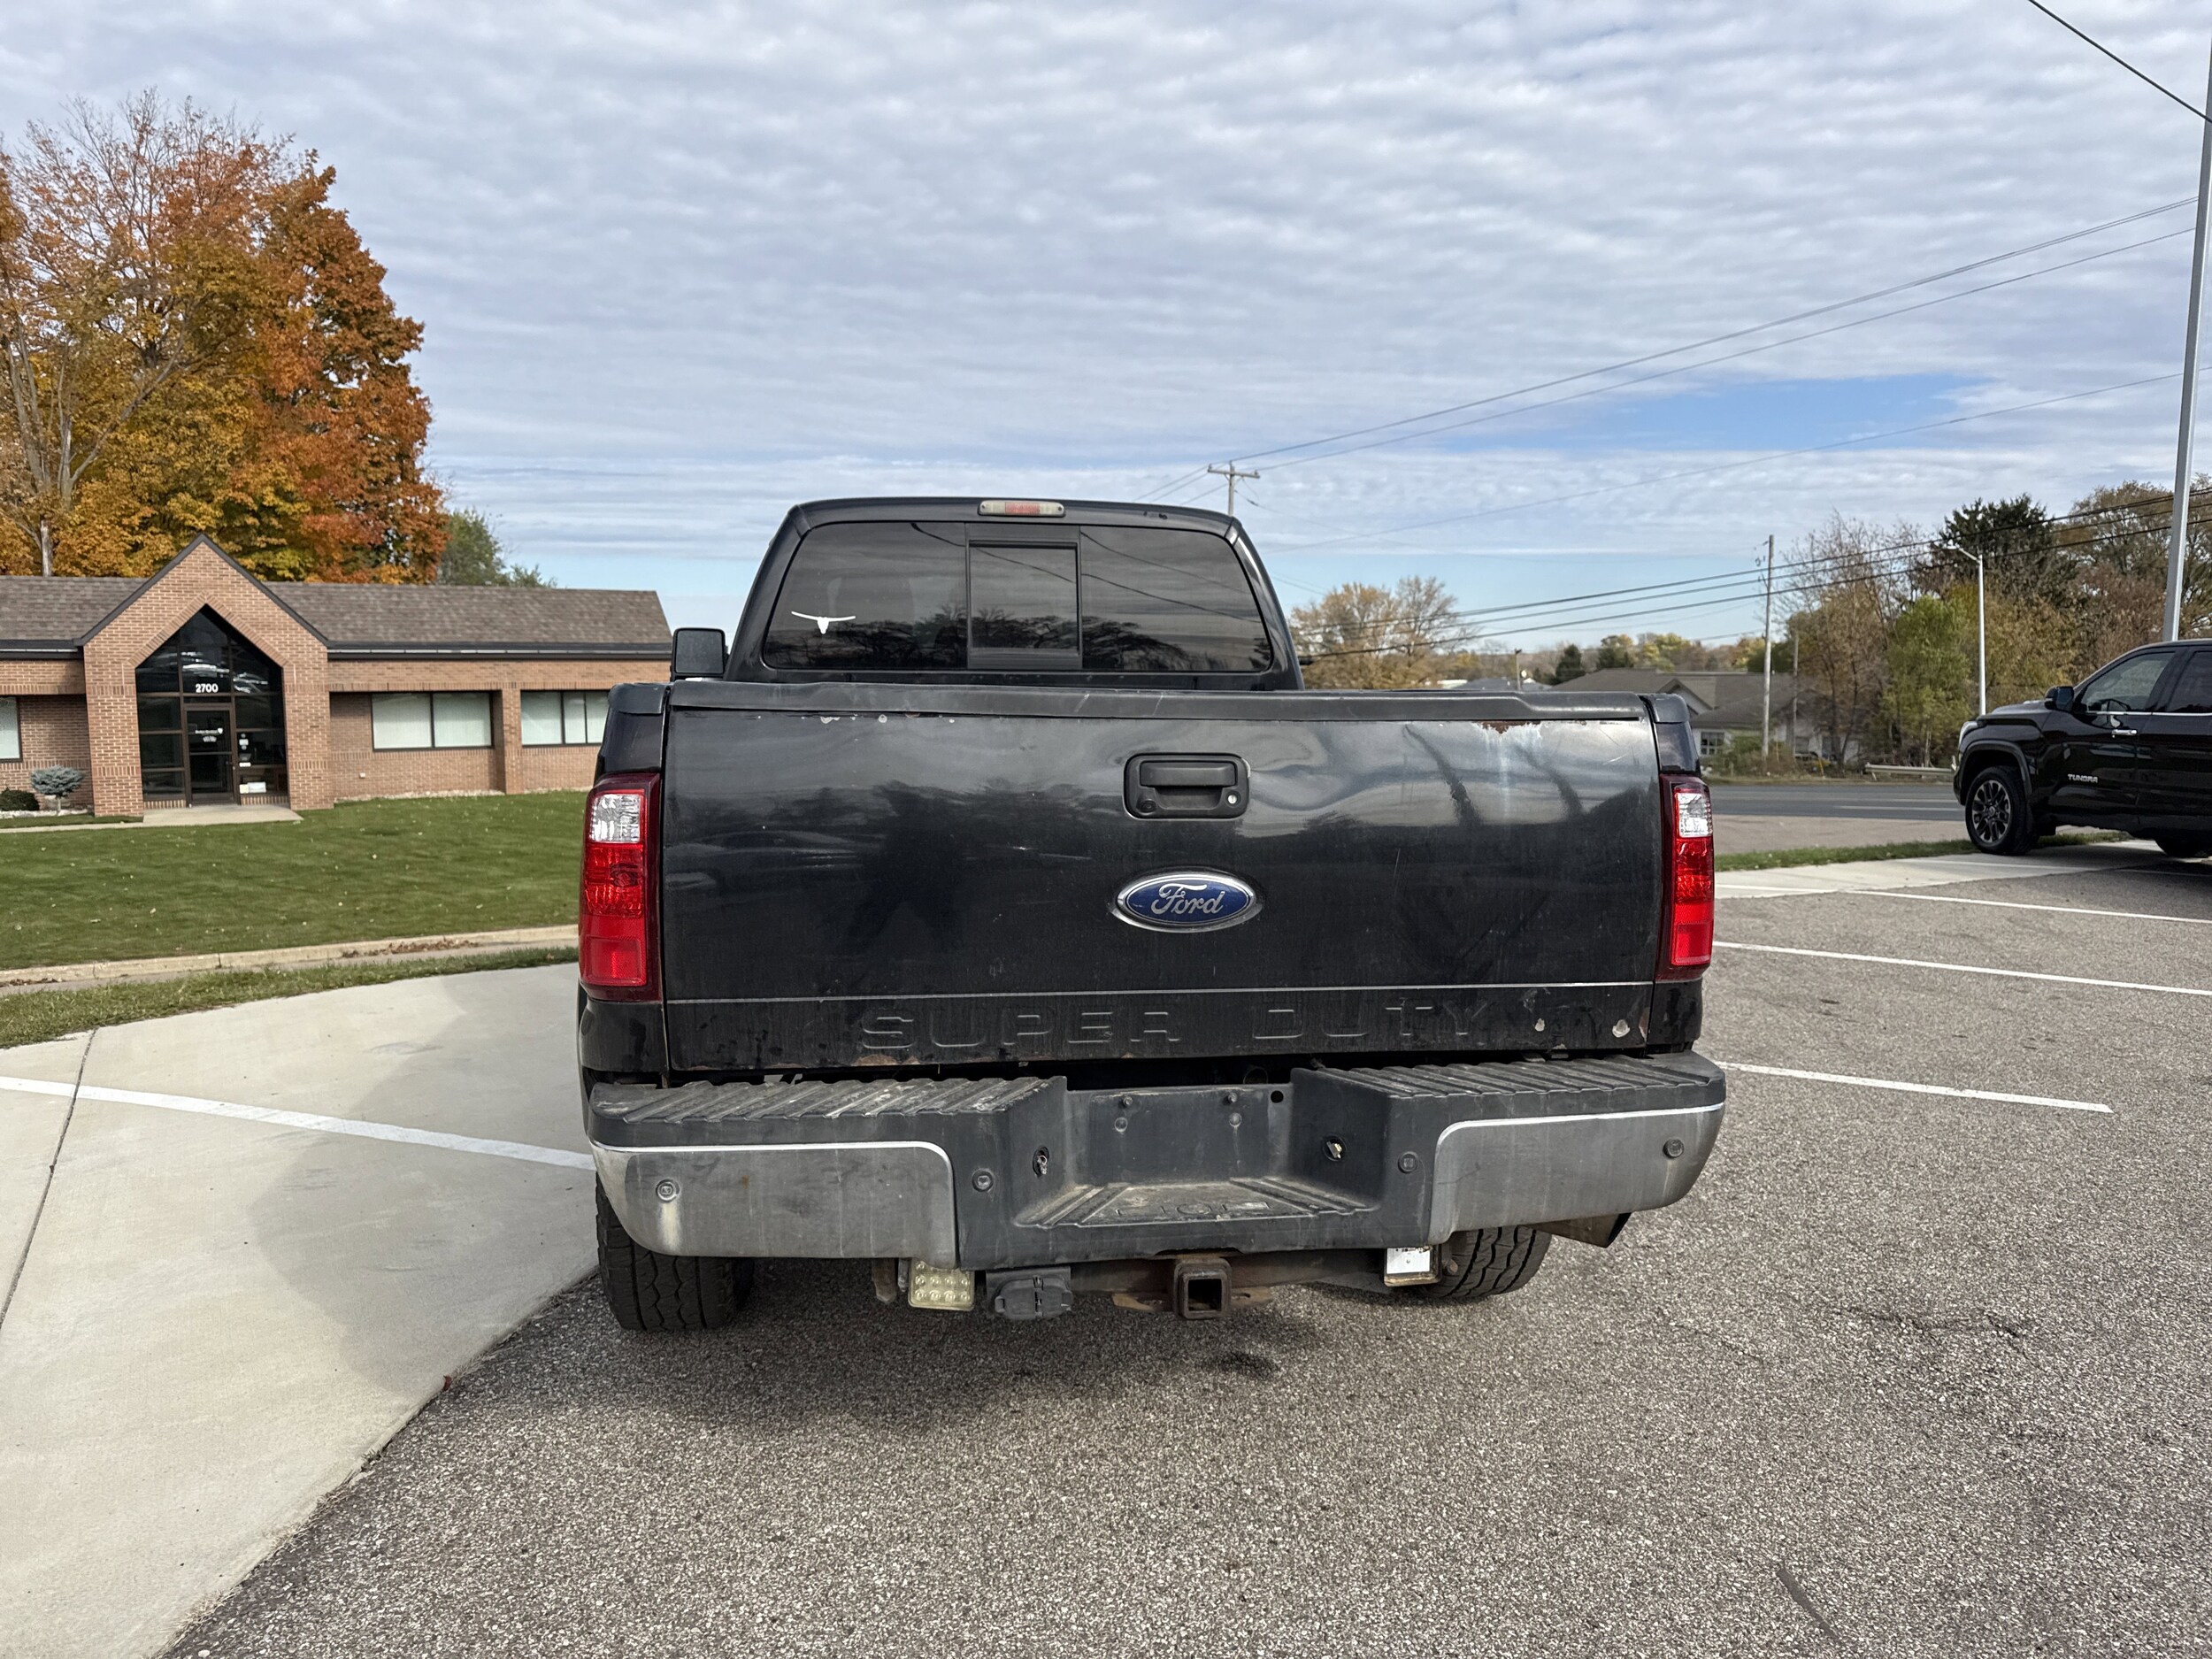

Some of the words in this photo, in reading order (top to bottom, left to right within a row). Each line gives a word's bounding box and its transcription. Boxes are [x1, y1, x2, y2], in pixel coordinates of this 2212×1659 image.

[196, 683, 219, 694] 2700
[2067, 773, 2098, 784] TUNDRA
[1150, 883, 1226, 915] Ford
[858, 1004, 1182, 1050] SUPER
[1251, 997, 1491, 1040] DUTY
